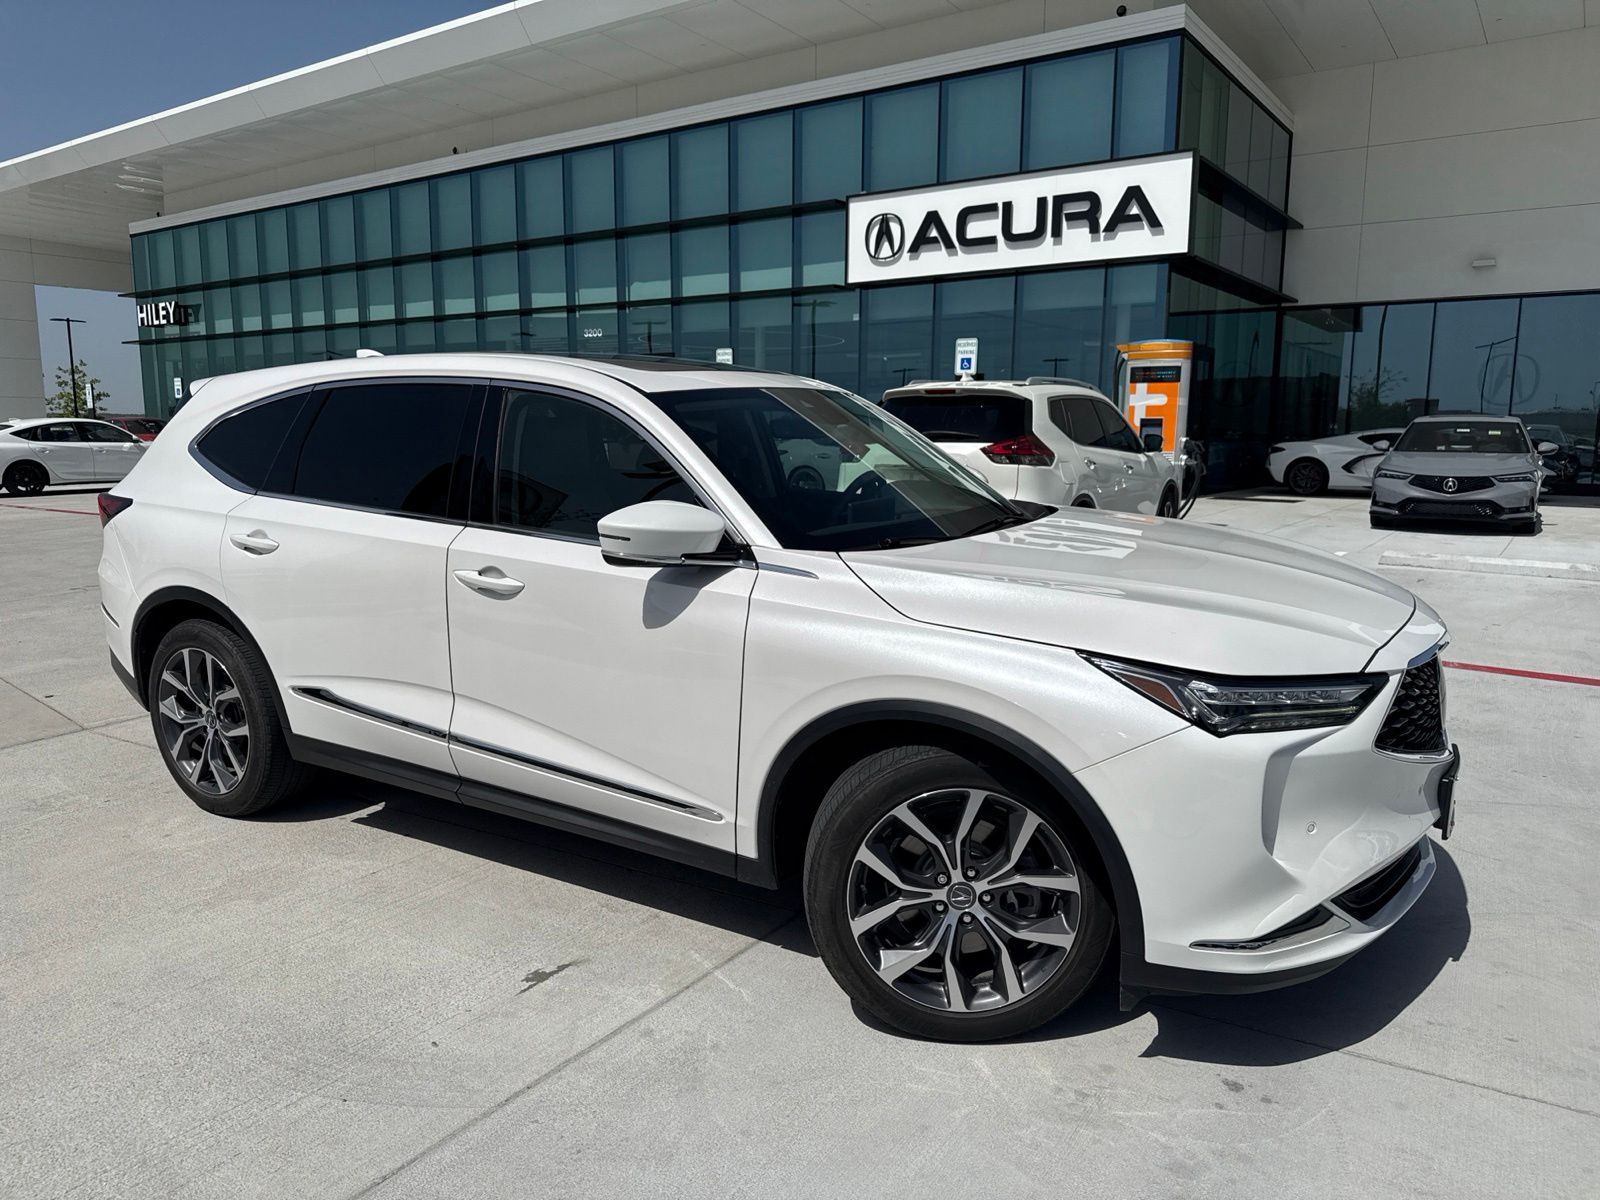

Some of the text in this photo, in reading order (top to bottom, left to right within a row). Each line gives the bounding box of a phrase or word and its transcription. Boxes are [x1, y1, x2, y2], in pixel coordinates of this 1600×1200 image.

[907, 185, 1164, 254] ACURA
[137, 301, 175, 327] HILEY
[583, 328, 603, 338] 3200
